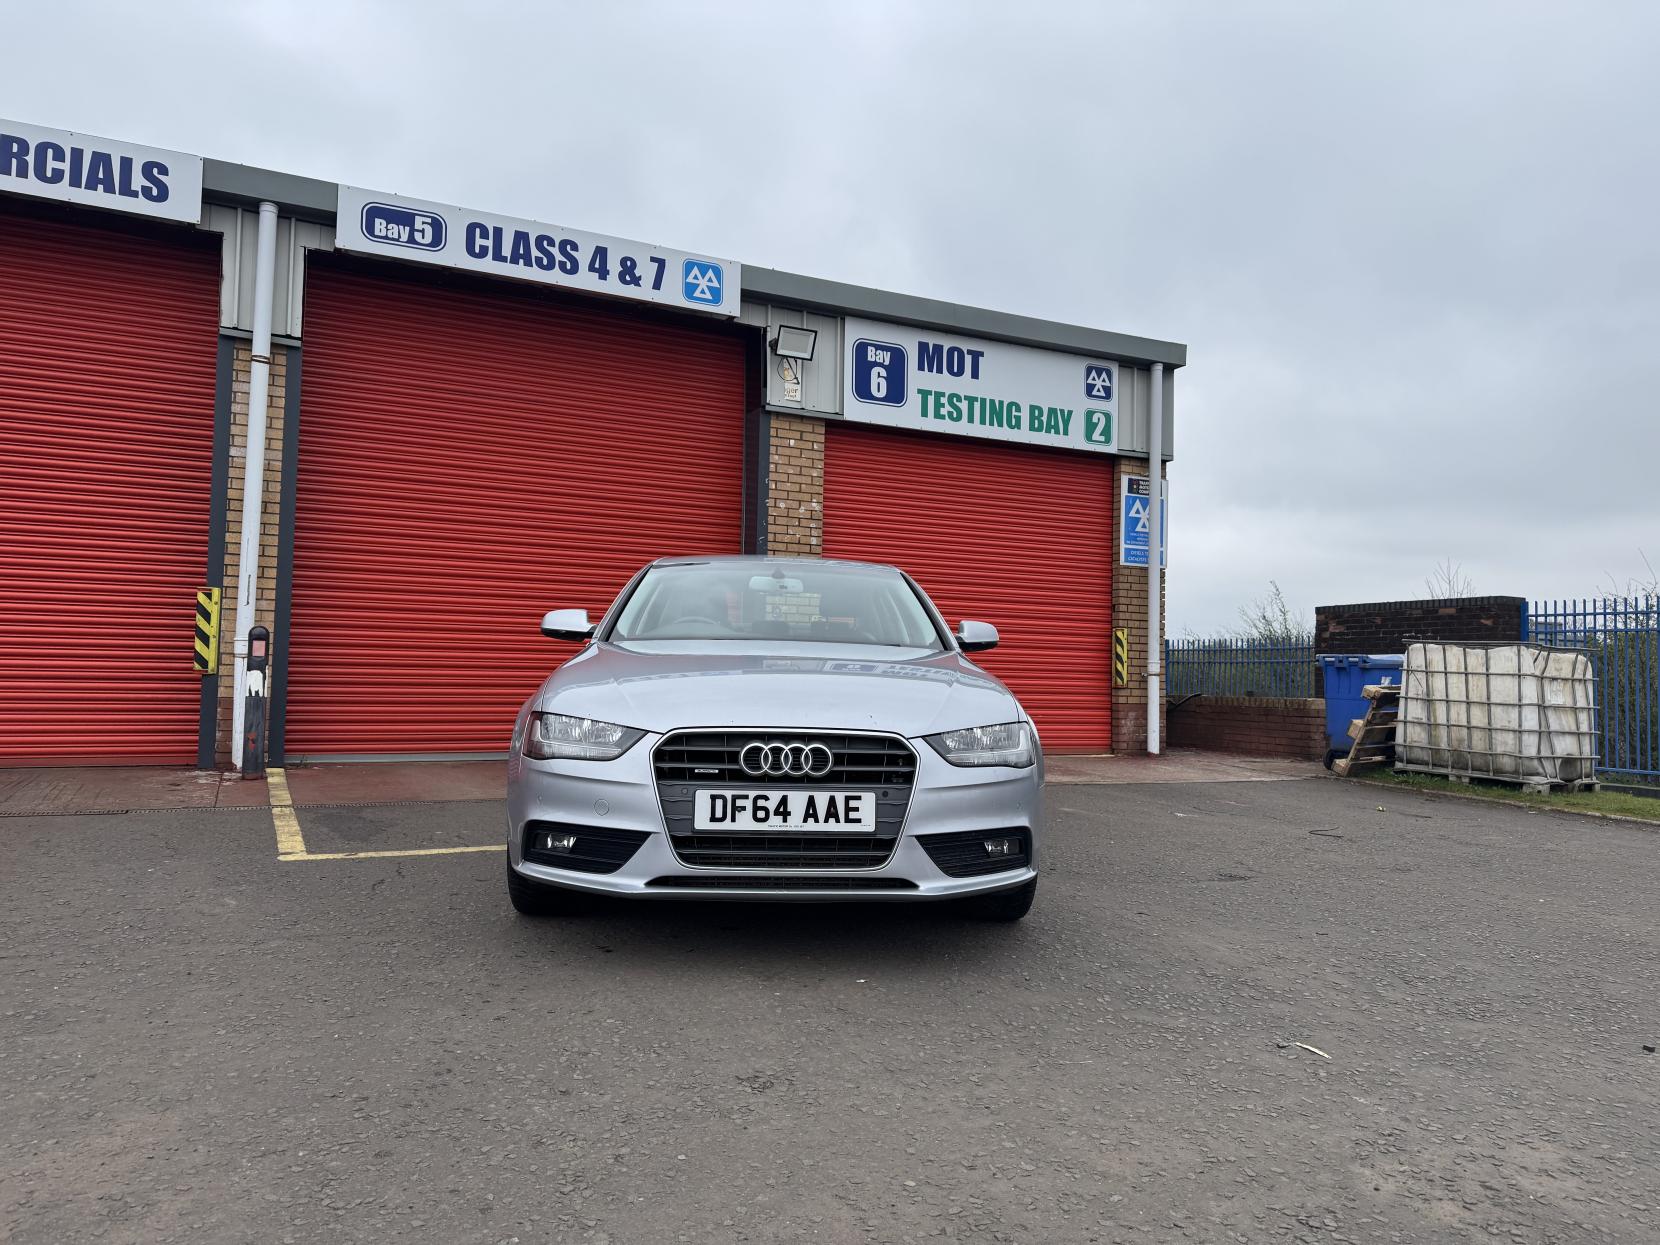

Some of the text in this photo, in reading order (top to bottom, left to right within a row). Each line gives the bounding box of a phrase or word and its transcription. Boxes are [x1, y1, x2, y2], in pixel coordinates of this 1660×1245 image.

[0, 133, 169, 203] RCIALS
[374, 216, 433, 245] Bay 5
[465, 221, 666, 291] CLASS 4 & 7
[867, 345, 891, 366] Bay
[917, 340, 985, 380] MOT
[870, 366, 887, 398] 6
[916, 388, 1106, 442] TESTING BAY 2
[709, 794, 862, 823] DF64 AAE
